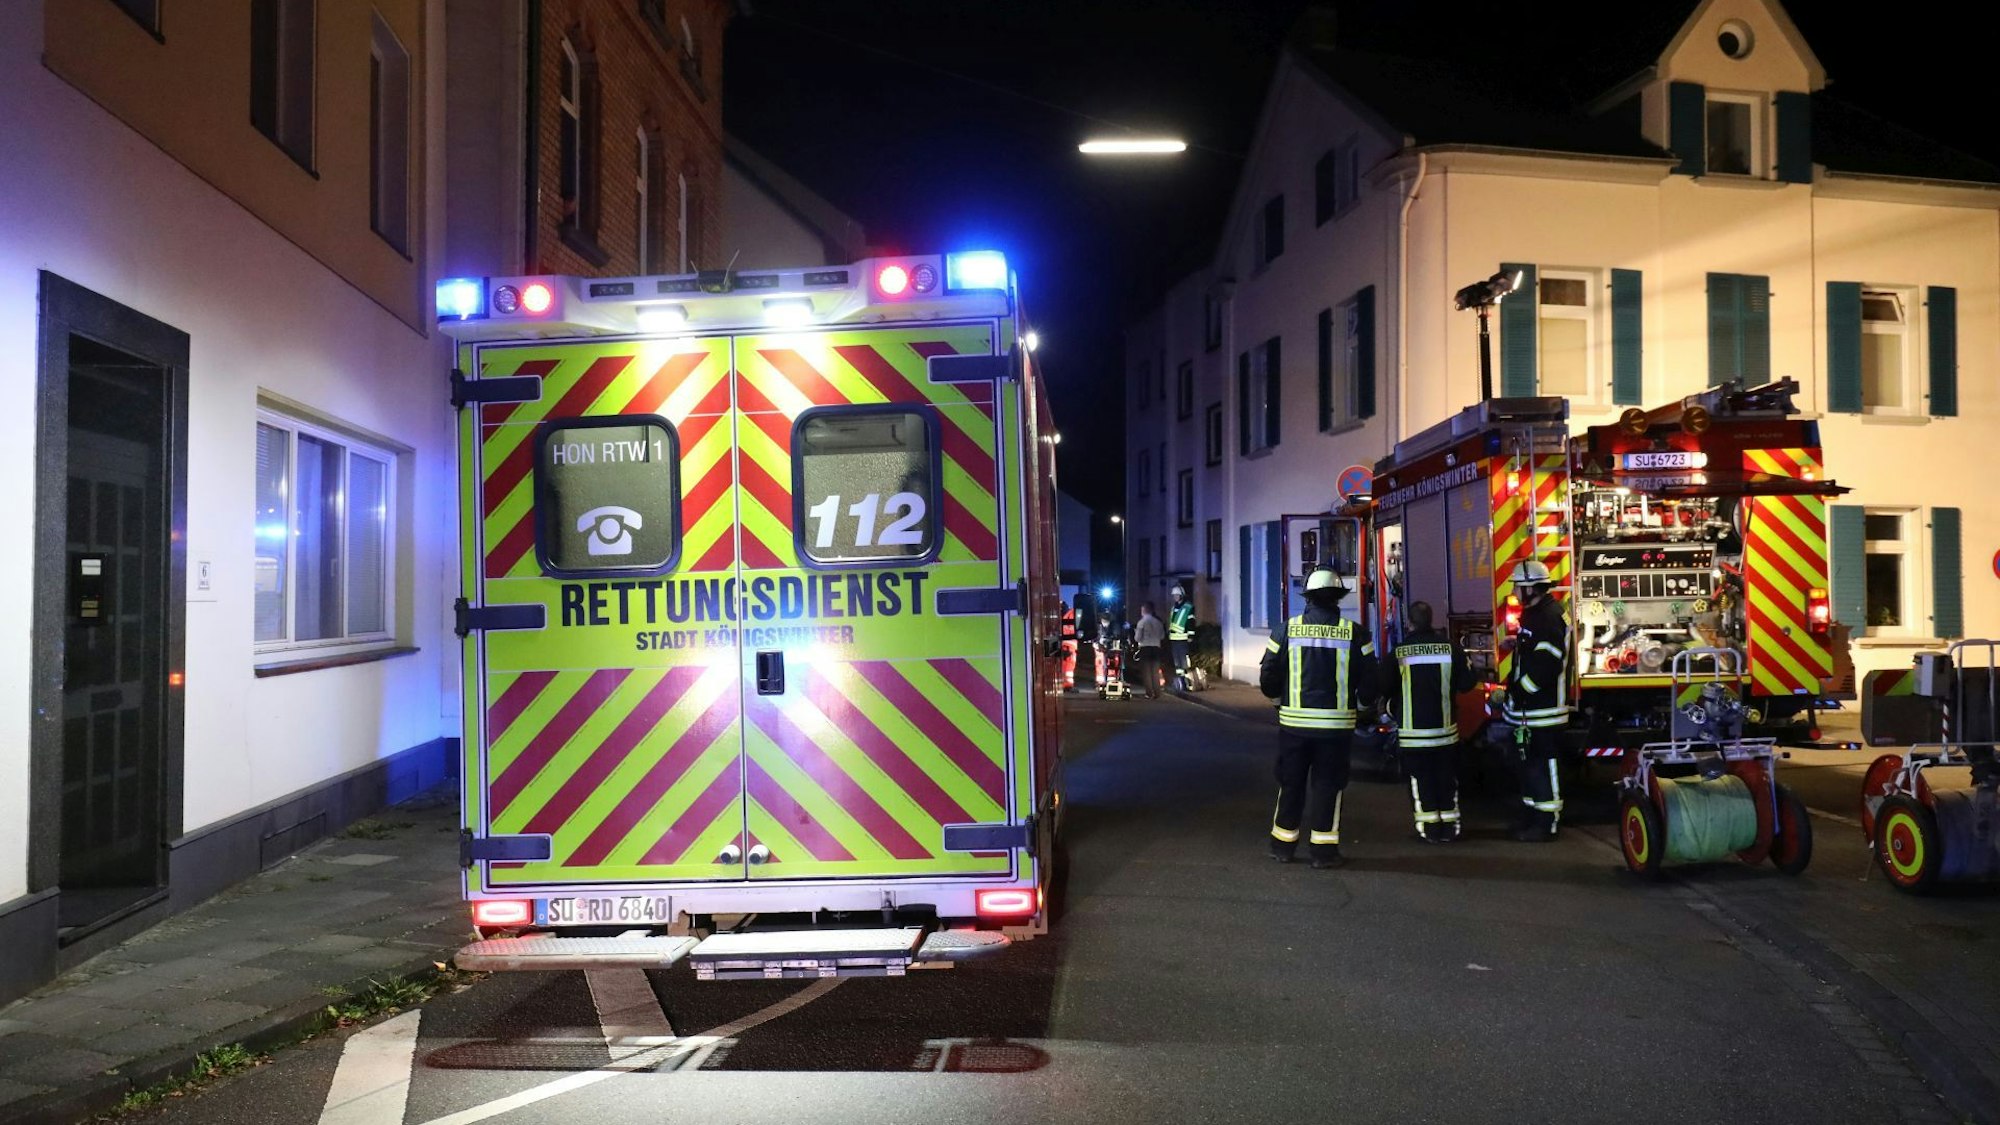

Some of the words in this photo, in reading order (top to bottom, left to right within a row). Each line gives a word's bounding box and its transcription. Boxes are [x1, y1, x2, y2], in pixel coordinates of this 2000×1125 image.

[553, 442, 595, 465] HON
[602, 440, 646, 463] RTW
[653, 440, 663, 460] 1
[1635, 454, 1650, 467] SU
[1657, 453, 1686, 466] 6723
[1378, 484, 1416, 511] FEUERWEHR
[1416, 461, 1478, 497] KÖNIGSWINTER
[810, 491, 926, 548] 112
[1452, 526, 1490, 580] 112
[561, 571, 929, 627] RETTUNGSDIENST
[636, 628, 698, 651] STADT
[1289, 624, 1350, 639] FEUERWEHR
[1397, 643, 1451, 658] FEUERWEHR
[548, 898, 574, 922] SU
[588, 898, 613, 921] RD
[618, 897, 667, 921] 6840
